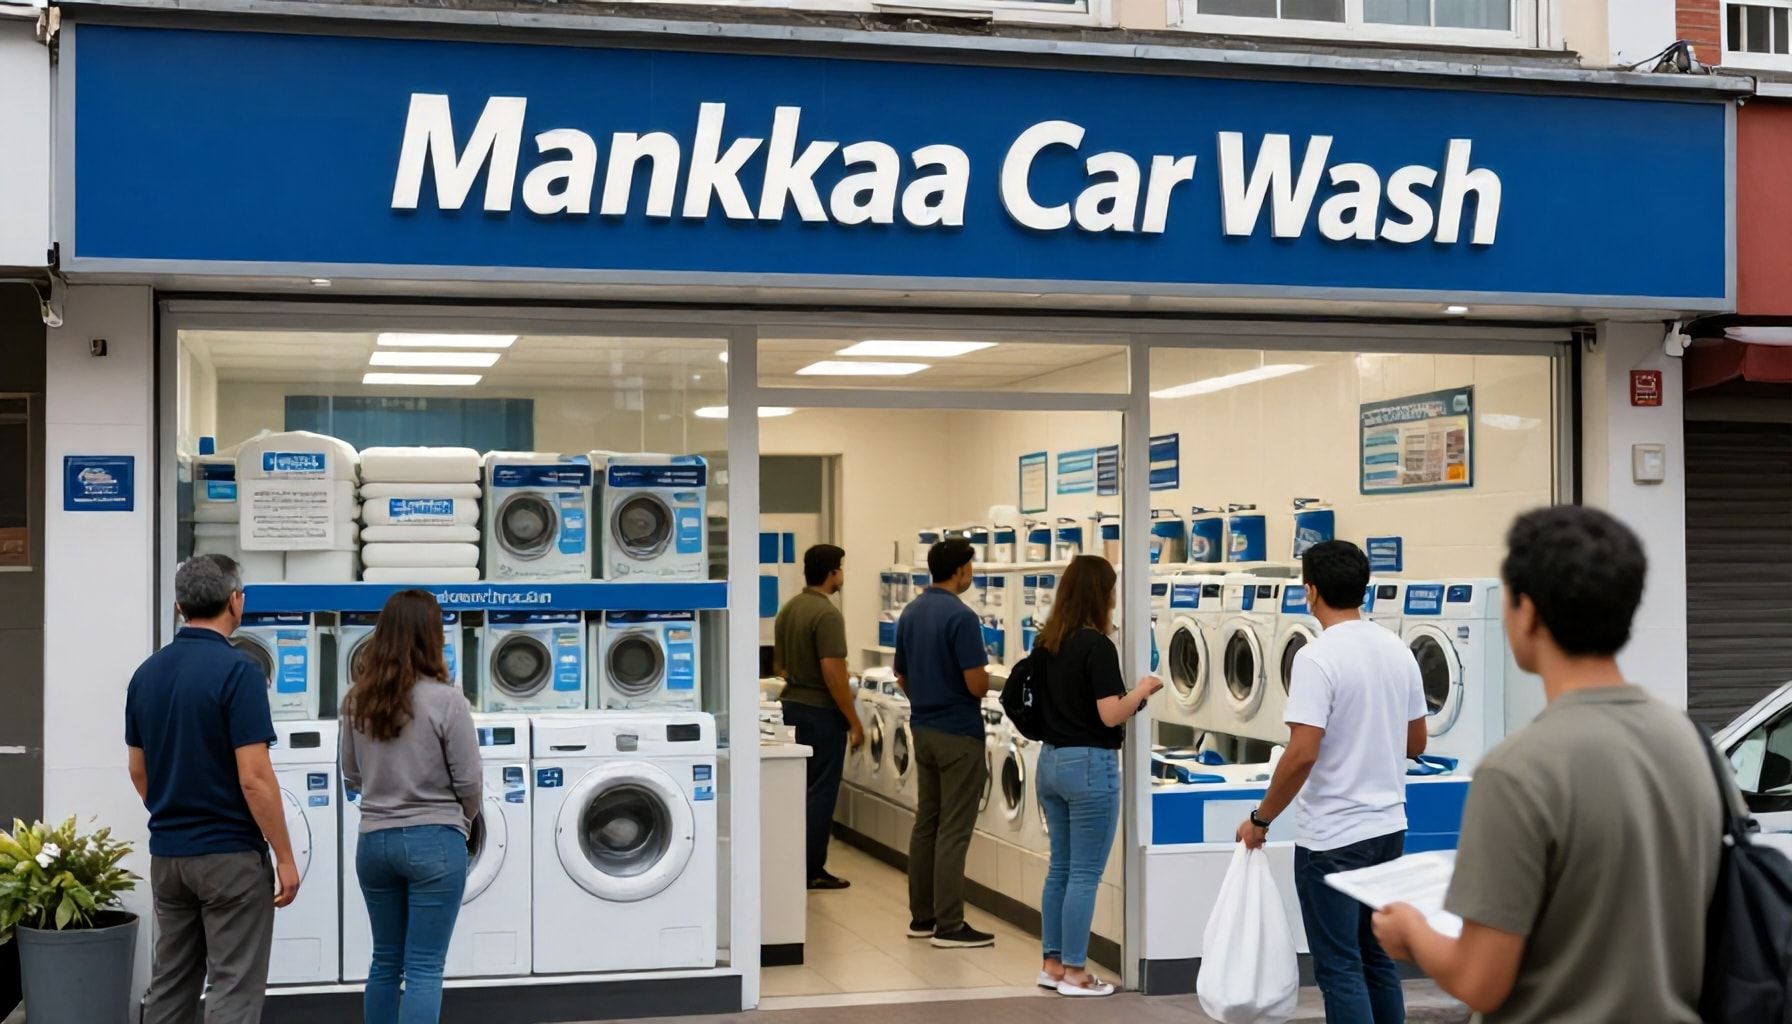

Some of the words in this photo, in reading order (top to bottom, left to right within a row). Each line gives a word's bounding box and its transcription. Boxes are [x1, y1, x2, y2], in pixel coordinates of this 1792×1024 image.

[391, 93, 970, 229] Mankkaa
[1001, 121, 1196, 235] Car
[1218, 131, 1503, 245] Wash
